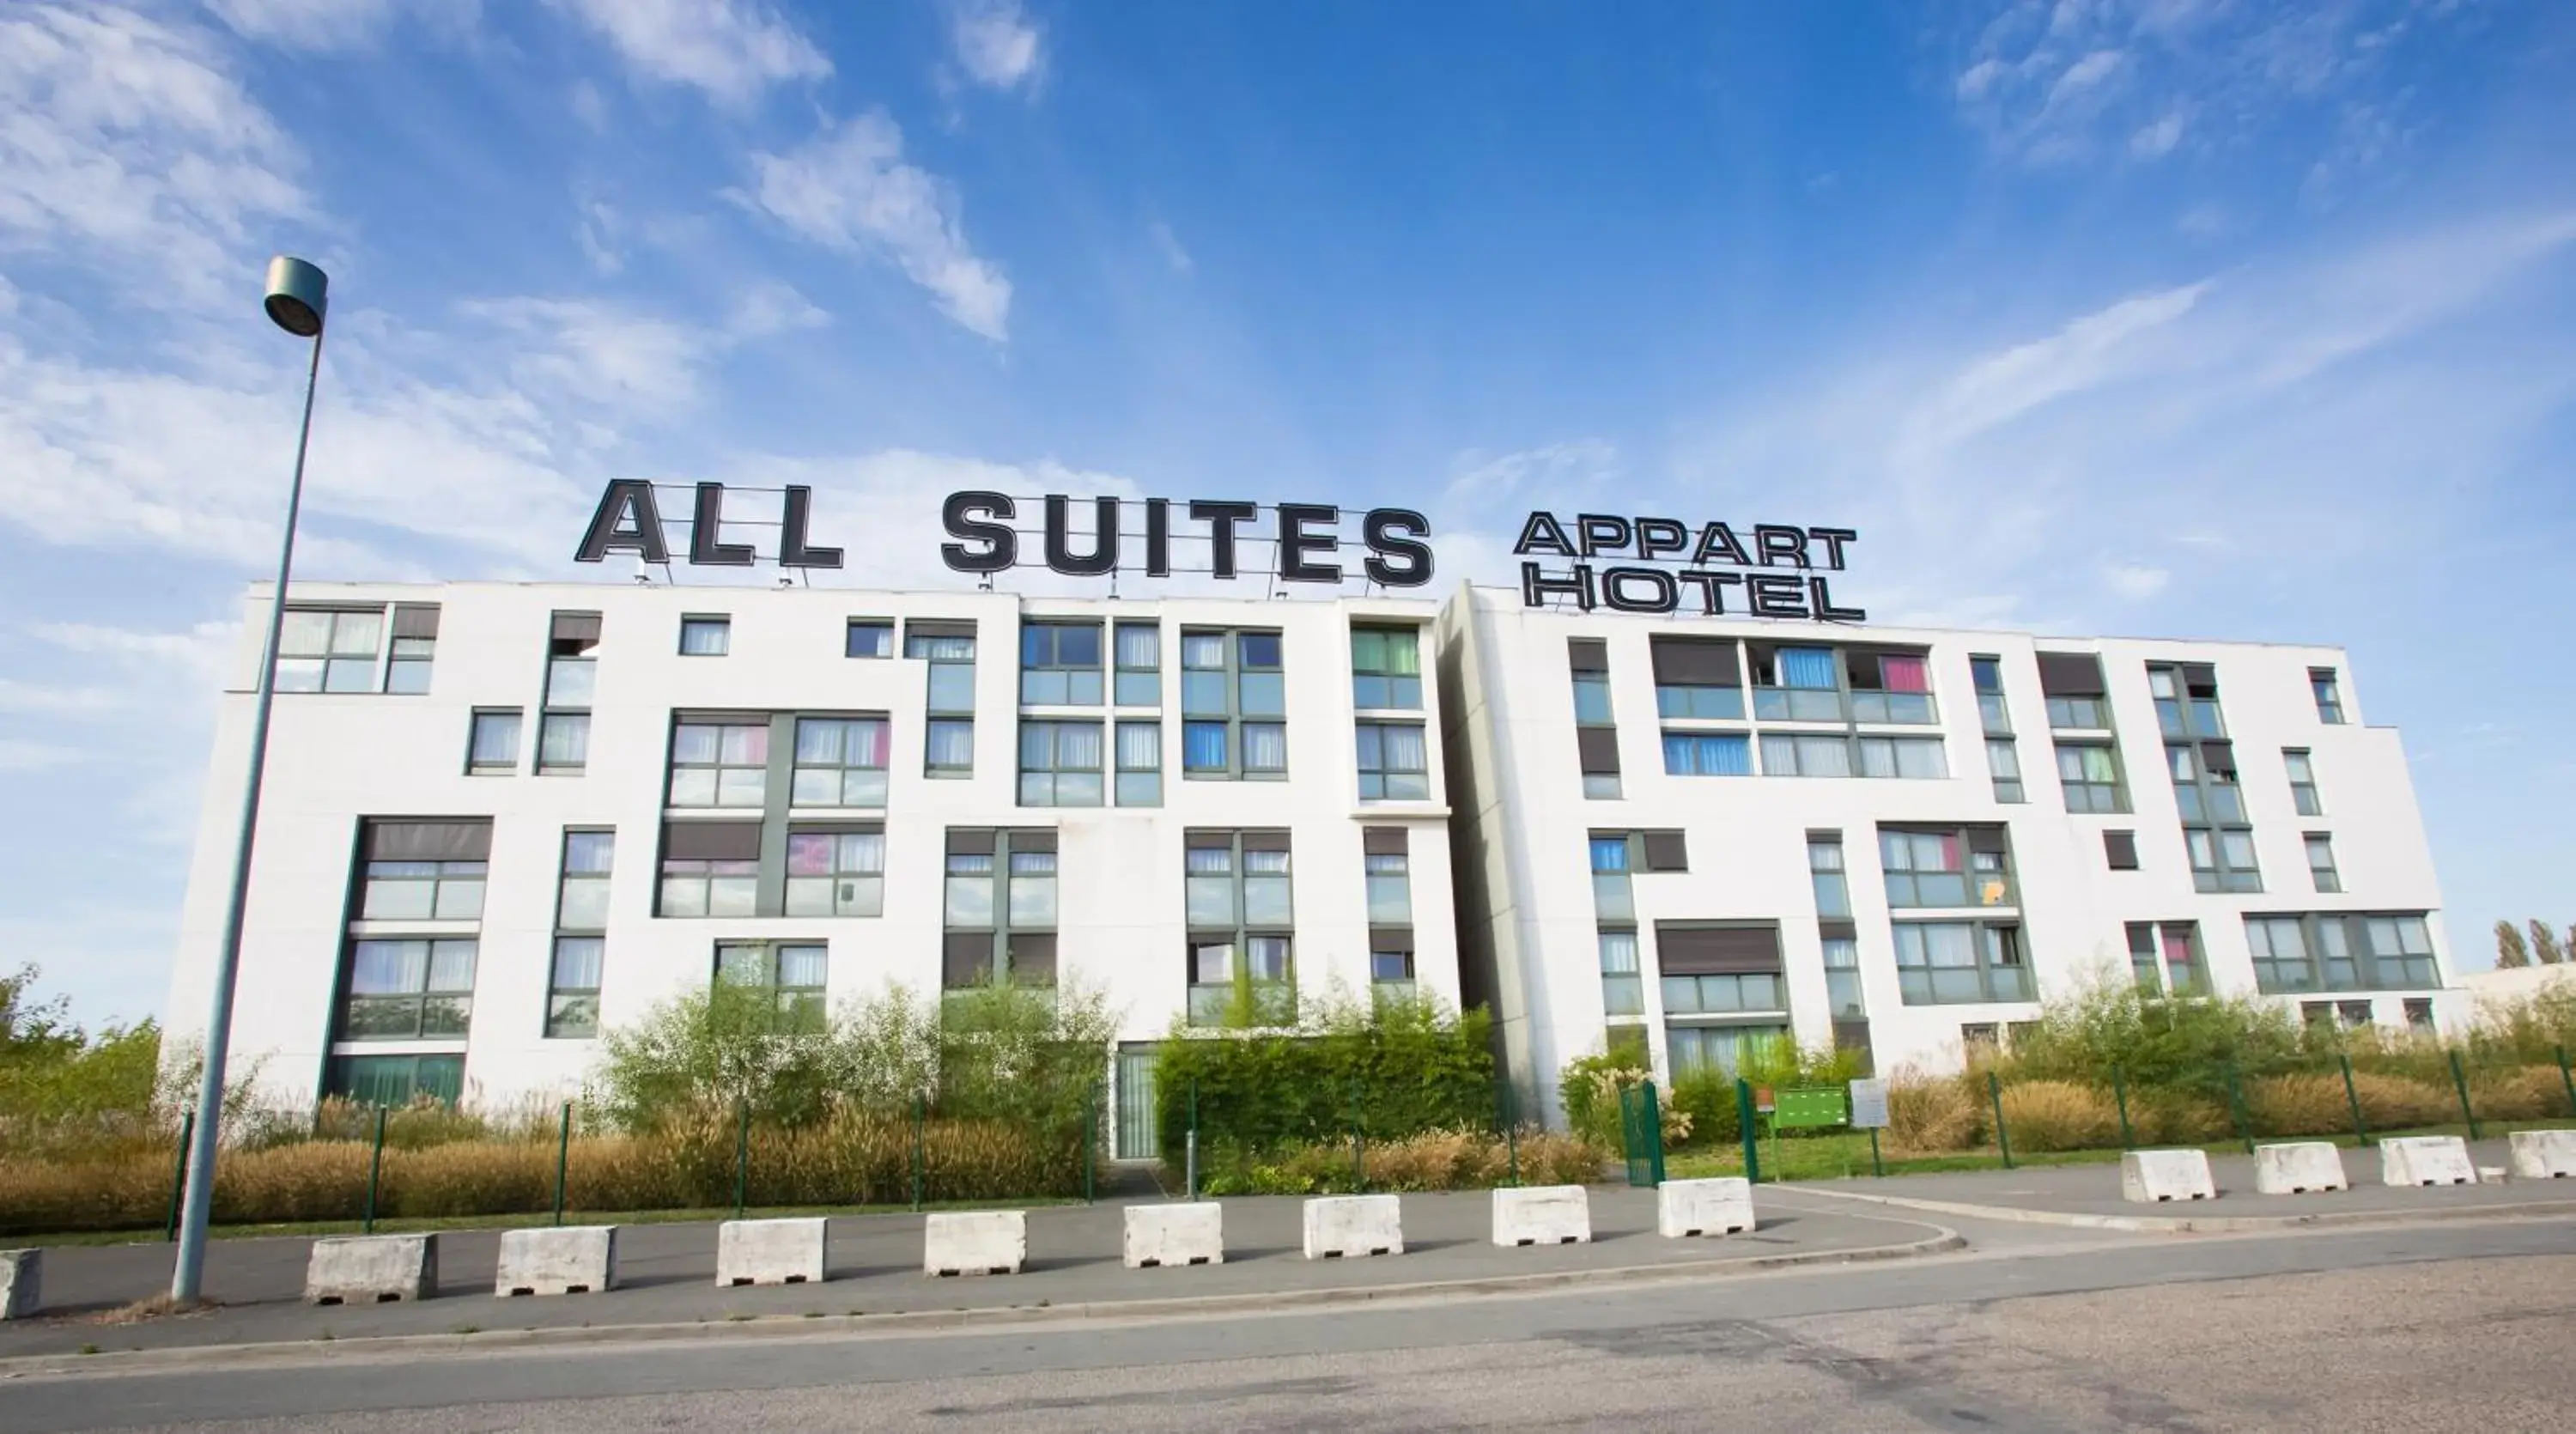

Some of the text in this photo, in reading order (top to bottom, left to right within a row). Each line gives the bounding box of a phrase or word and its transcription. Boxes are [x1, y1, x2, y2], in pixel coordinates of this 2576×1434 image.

[574, 479, 1434, 586] ALL SUITES
[1513, 511, 1856, 570] APPART
[1522, 562, 1866, 621] HOTEL
